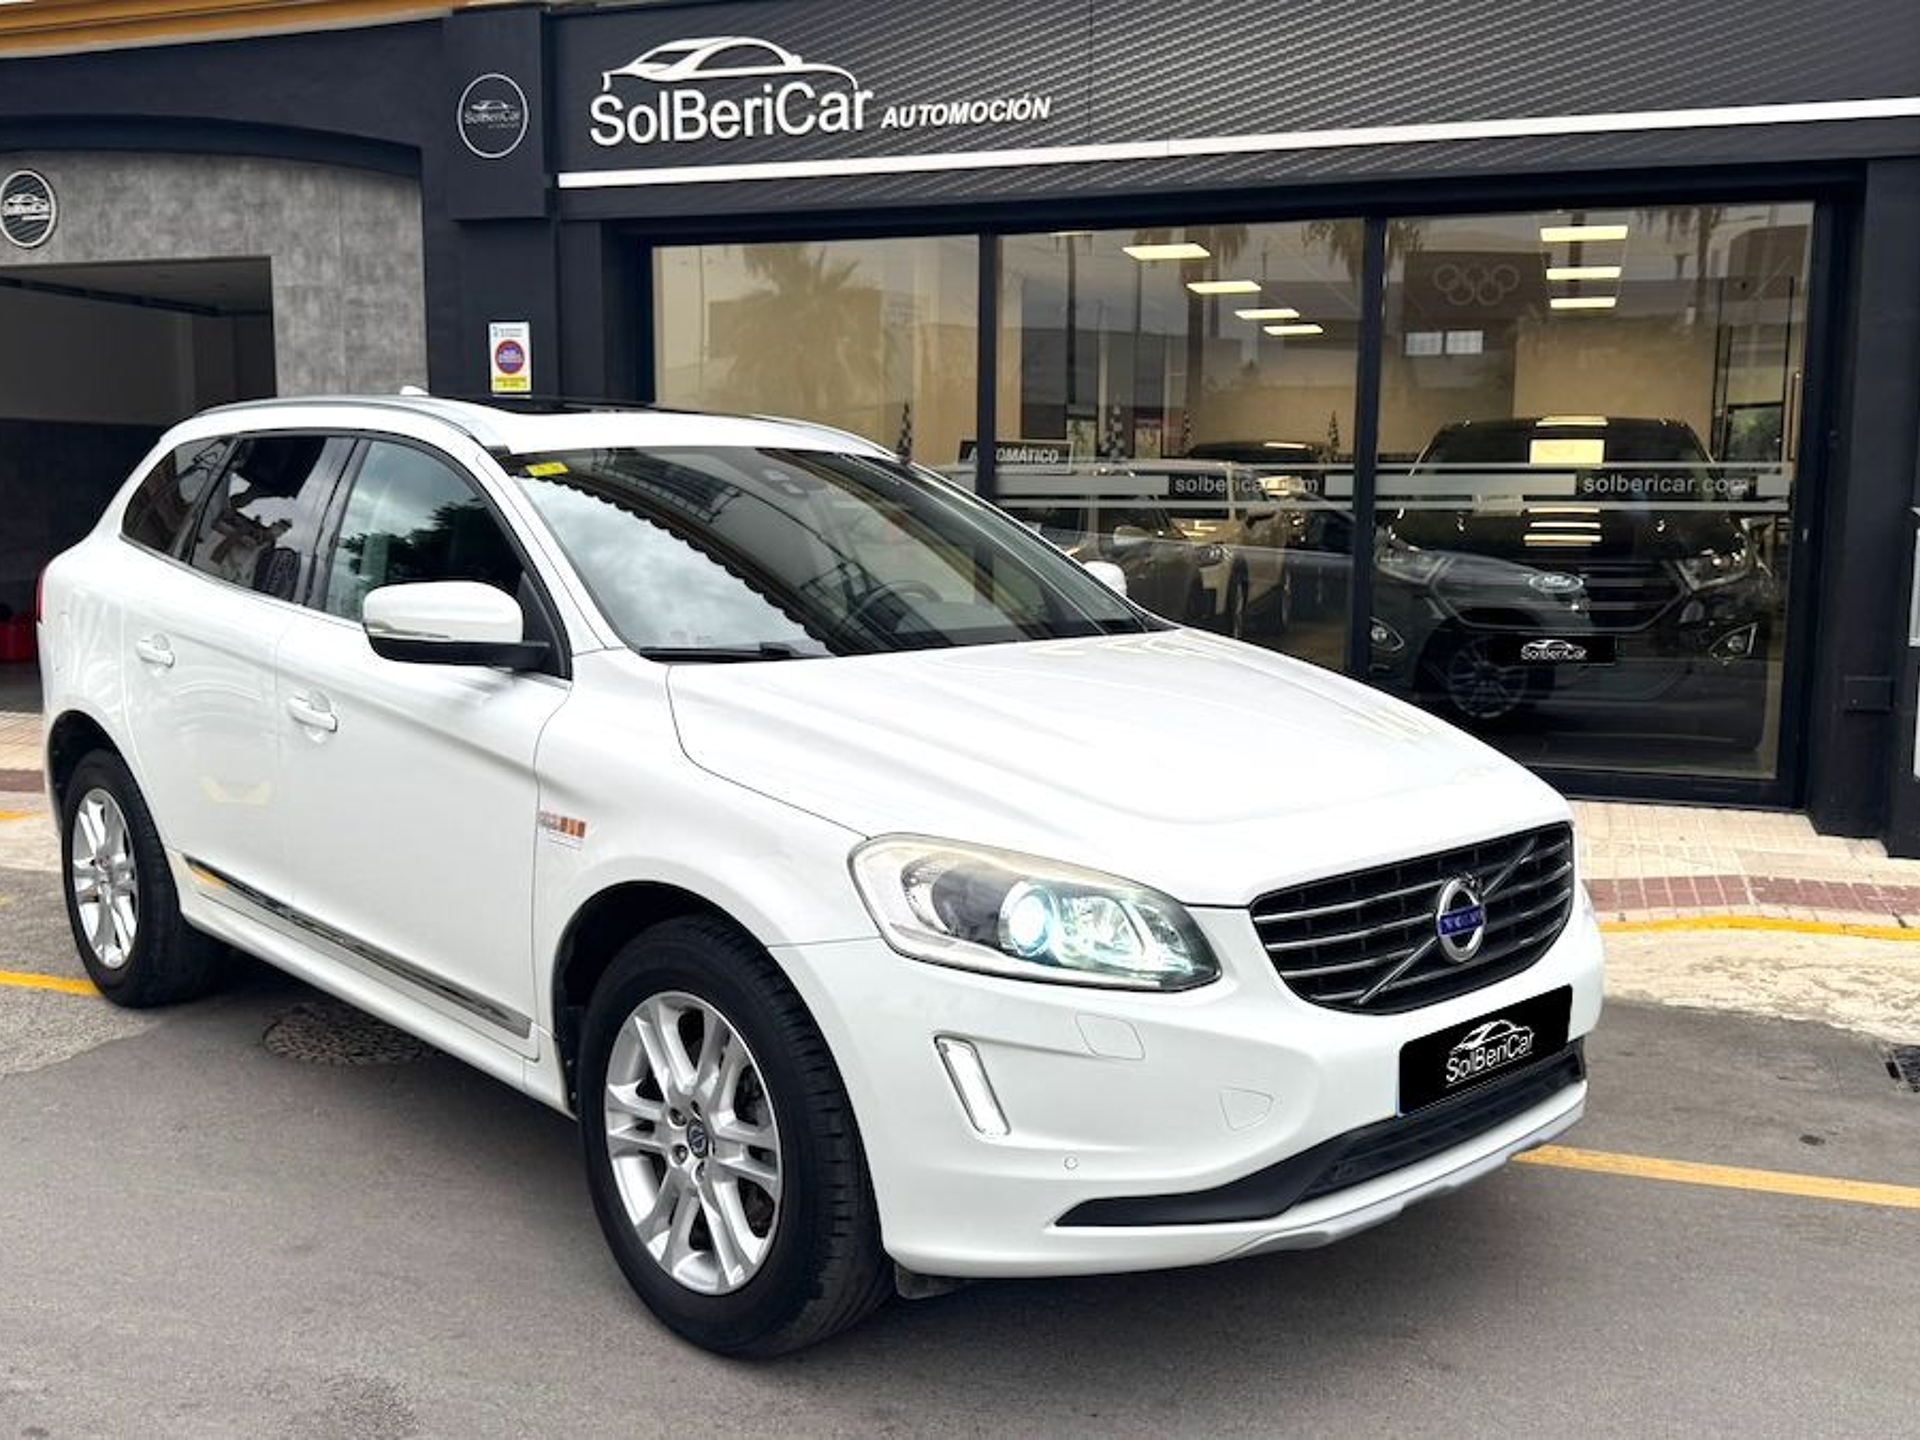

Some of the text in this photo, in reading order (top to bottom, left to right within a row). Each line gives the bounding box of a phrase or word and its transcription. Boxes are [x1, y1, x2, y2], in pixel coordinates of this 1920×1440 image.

[590, 83, 1051, 146] SolBeriCar AUTOMOCIÓN
[968, 445, 1060, 464] AOMÁTICO
[1174, 474, 1319, 493] solbeicarcom
[1446, 1031, 1536, 1082] SolBeriCar
